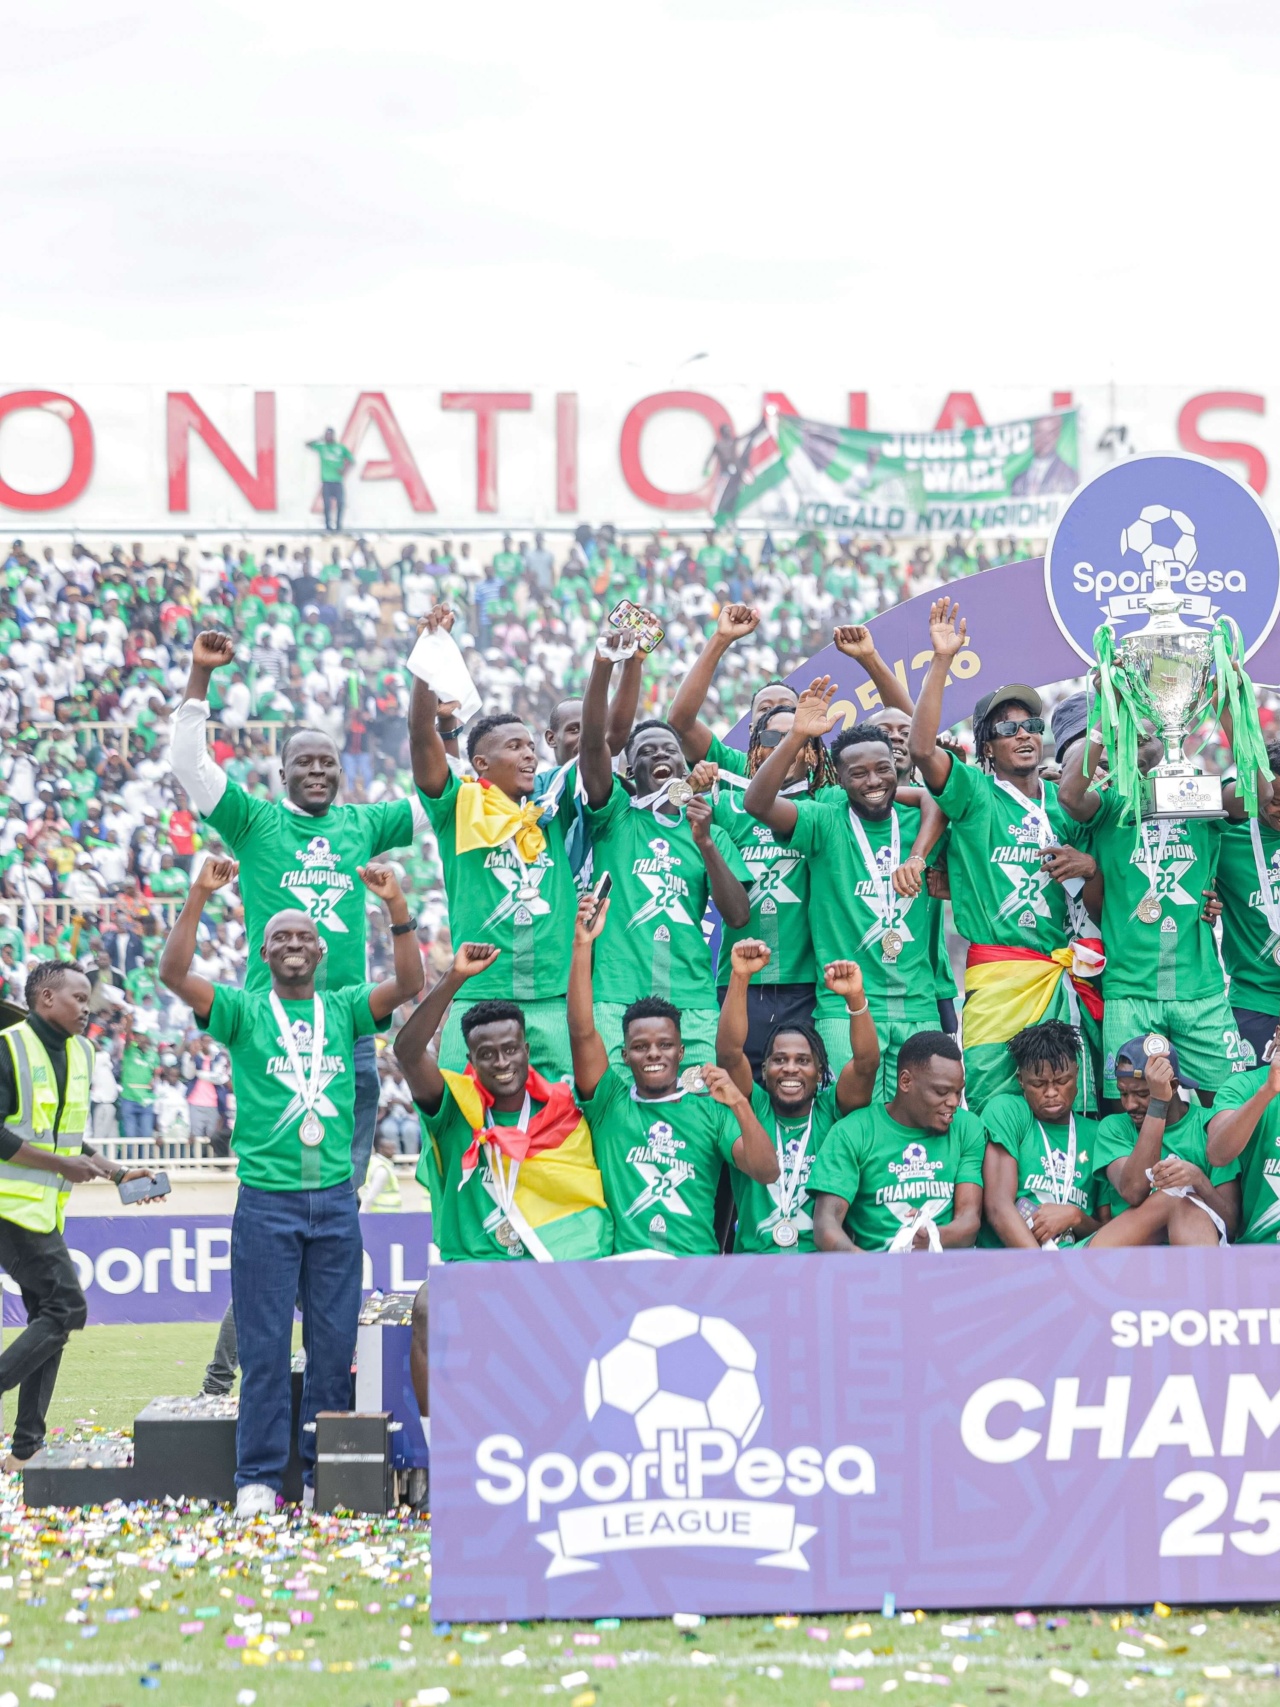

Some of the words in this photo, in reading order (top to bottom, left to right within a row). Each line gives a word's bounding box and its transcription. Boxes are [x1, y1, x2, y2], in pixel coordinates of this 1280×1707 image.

[166, 391, 1073, 513] NATIO
[1127, 597, 1193, 610] LEE
[280, 869, 355, 891] CHAMPIONS
[759, 869, 780, 891] 22
[1017, 877, 1040, 901] 22
[1156, 872, 1176, 893] 22
[310, 898, 330, 918] 22
[655, 886, 675, 909] 22
[888, 1160, 943, 1175] SportPesa
[651, 1176, 673, 1198] 22
[475, 1427, 877, 1523] SportPesa
[602, 1507, 752, 1539] LEAGUE
